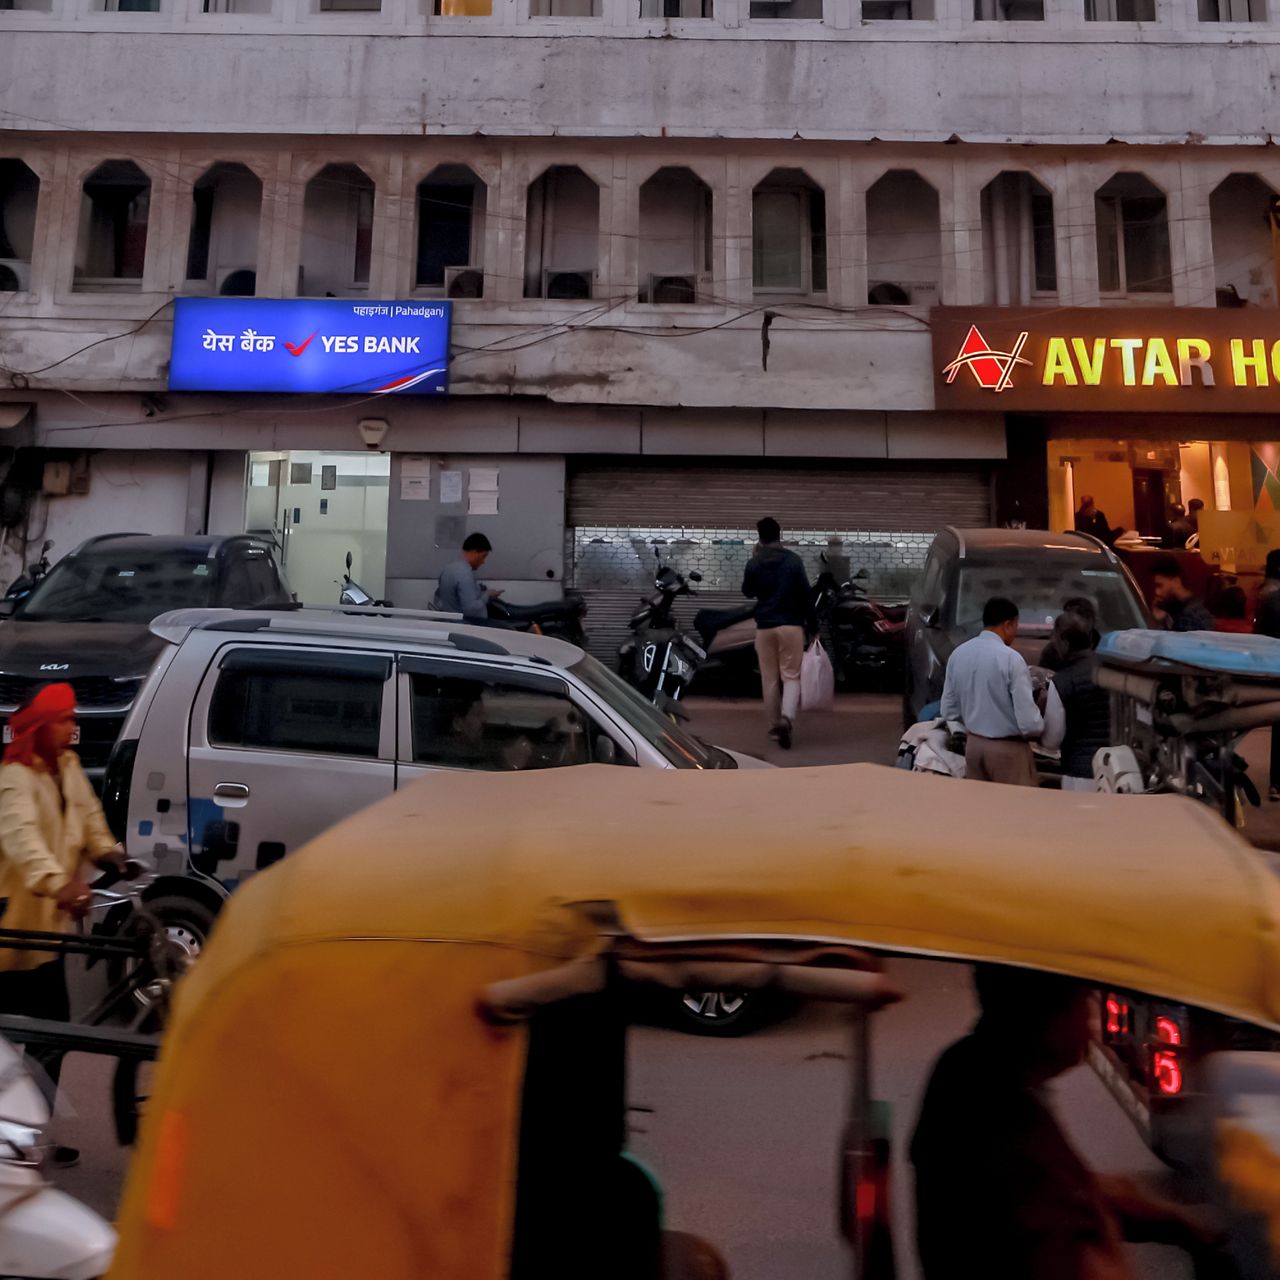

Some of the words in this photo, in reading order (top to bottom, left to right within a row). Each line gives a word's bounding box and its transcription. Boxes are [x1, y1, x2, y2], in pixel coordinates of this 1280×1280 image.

[395, 306, 444, 318] Pahadganj
[202, 329, 236, 353] येस
[240, 329, 276, 353] बैंक
[321, 336, 359, 354] YES
[364, 336, 421, 354] BANK
[1043, 337, 1216, 387] AVTAR
